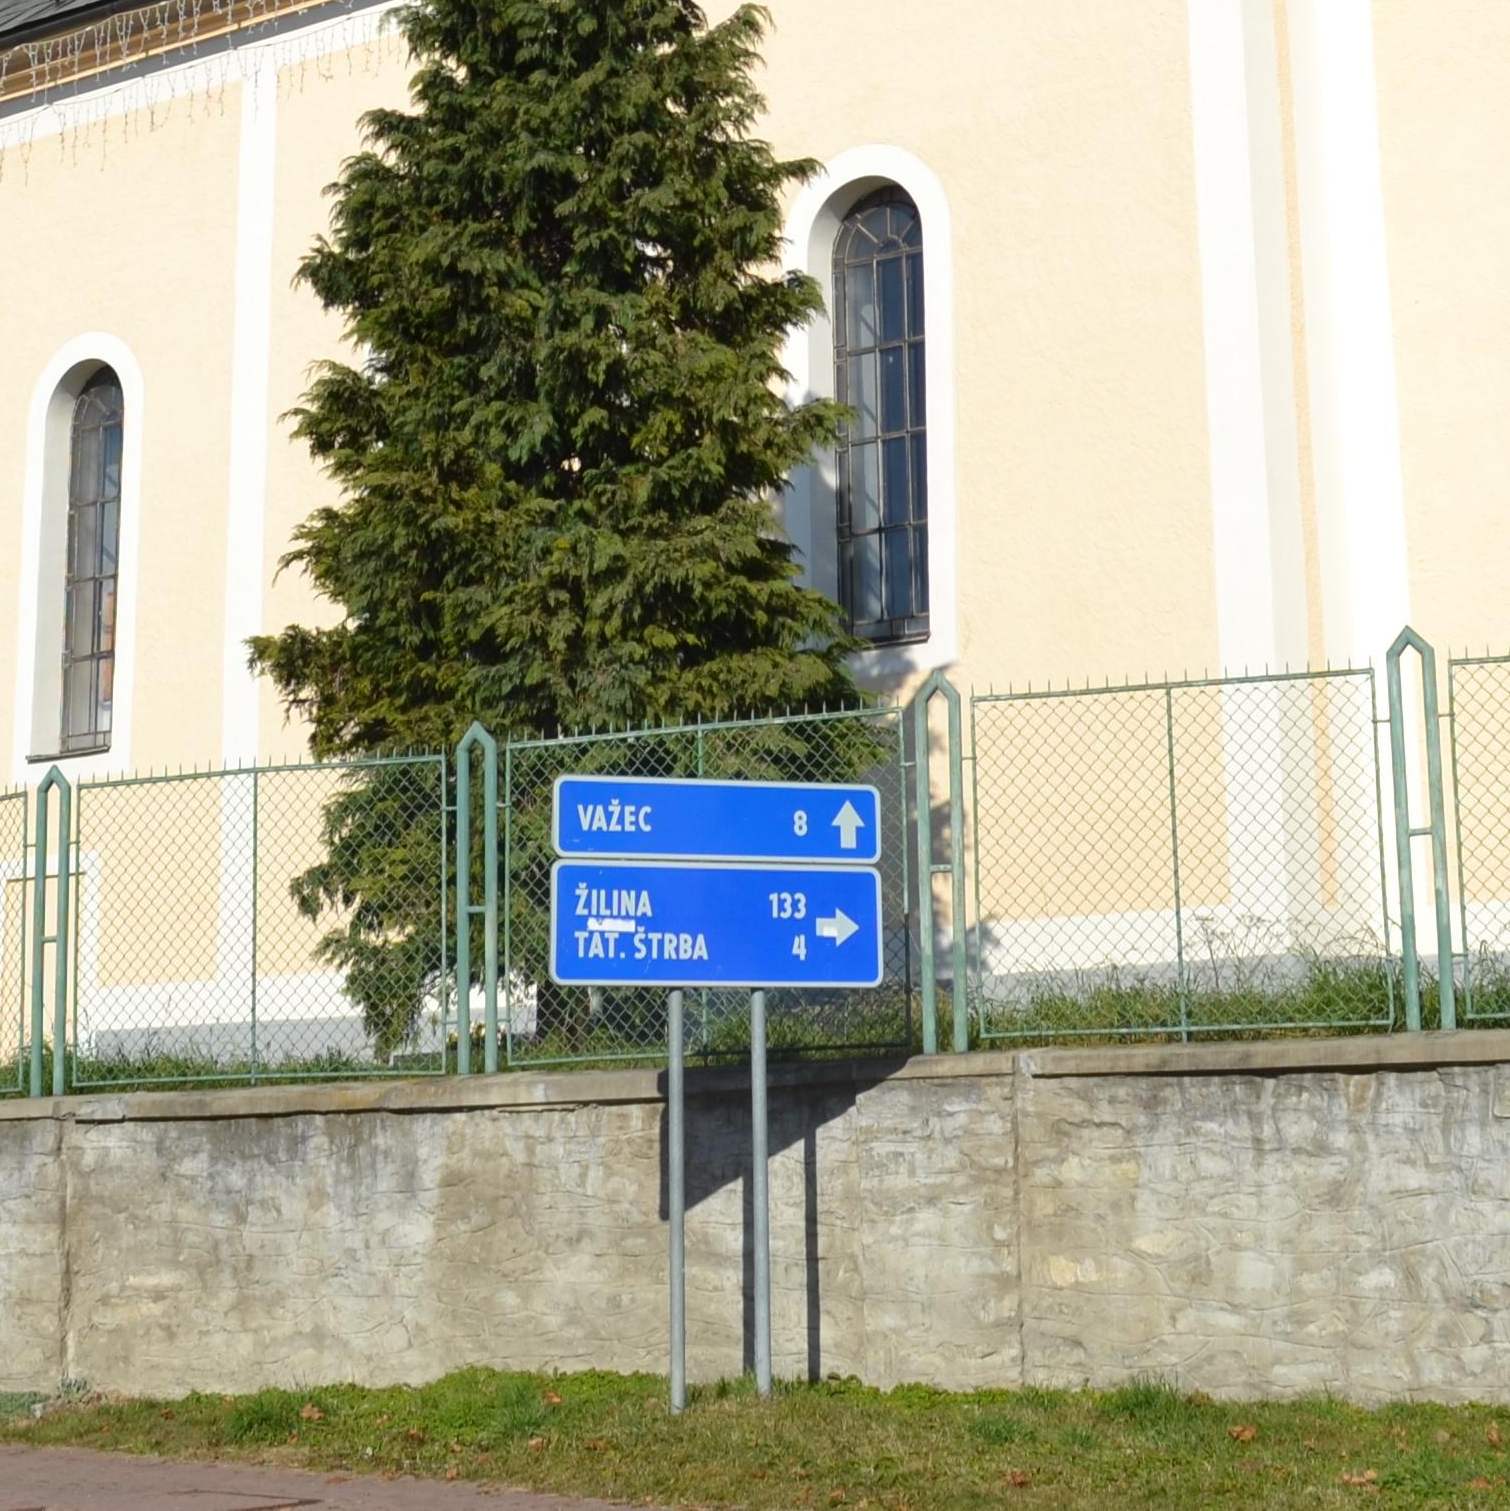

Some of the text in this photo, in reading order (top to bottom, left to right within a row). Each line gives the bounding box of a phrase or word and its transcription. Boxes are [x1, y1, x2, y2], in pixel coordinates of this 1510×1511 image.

[577, 798, 808, 837] VAŽEC 8
[575, 882, 807, 920] ŽILINA 133
[574, 926, 807, 961] TAT. ŠTRBA 4
